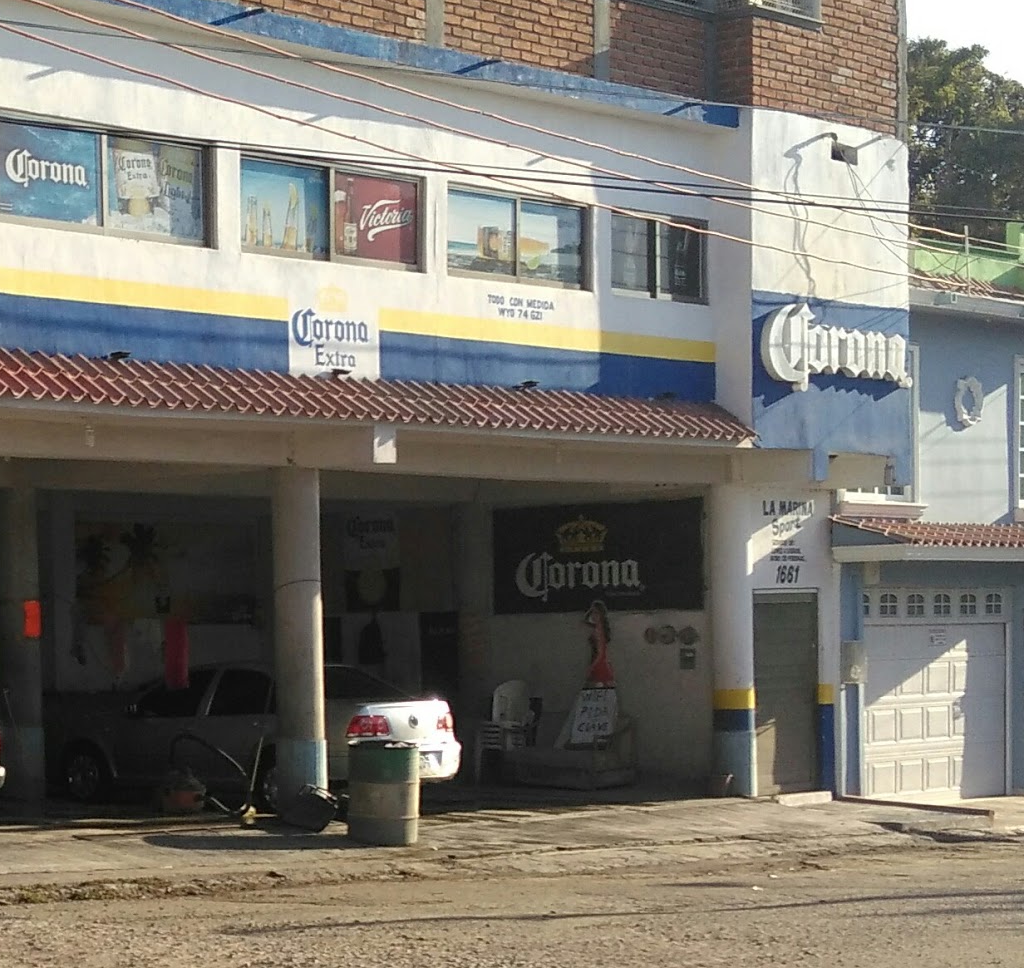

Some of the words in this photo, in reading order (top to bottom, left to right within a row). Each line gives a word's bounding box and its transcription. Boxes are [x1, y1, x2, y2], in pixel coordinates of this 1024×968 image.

[5, 149, 90, 188] Corona
[118, 156, 152, 171] Corona
[360, 199, 413, 241] Victoria
[487, 294, 505, 305] TODO
[509, 296, 524, 307] CON
[526, 299, 555, 311] MEDIDA
[517, 309, 529, 319] 74
[292, 308, 369, 347] Corona
[315, 344, 356, 367] Extra
[760, 303, 913, 392] Corona
[763, 500, 776, 516] LA
[779, 500, 813, 516] MARINA
[516, 552, 642, 602] Corona
[776, 564, 800, 584] 1661
